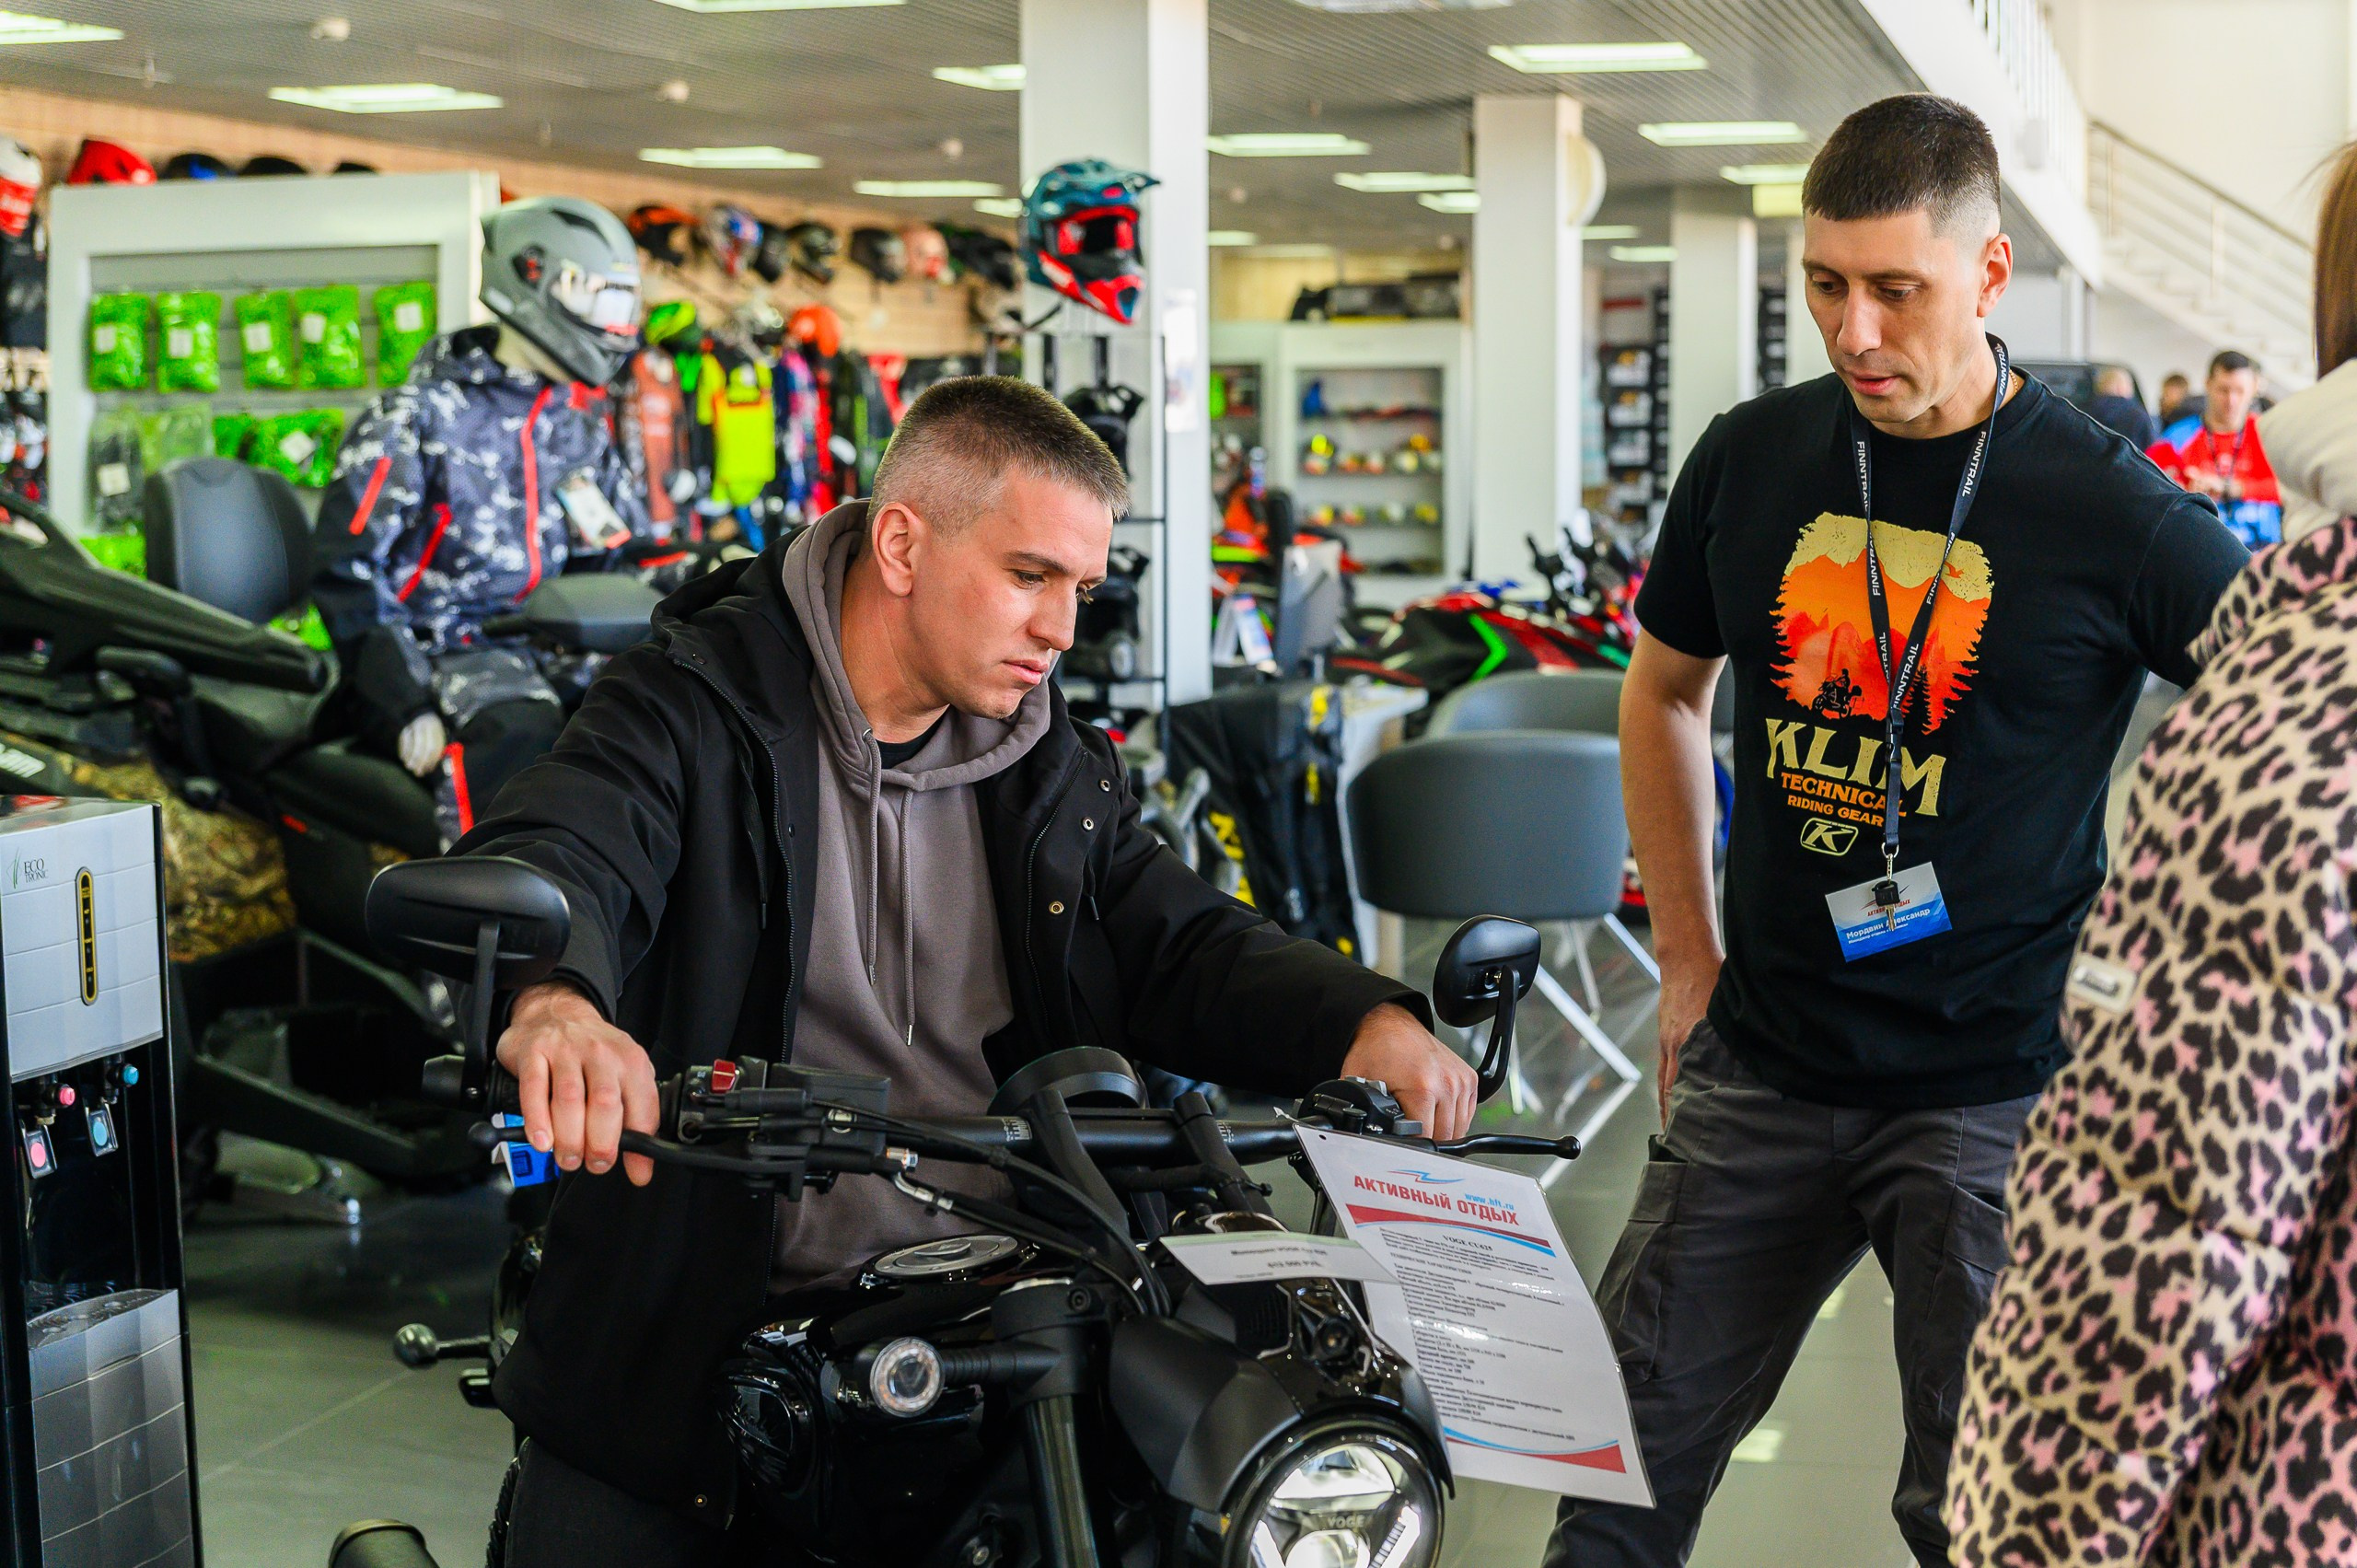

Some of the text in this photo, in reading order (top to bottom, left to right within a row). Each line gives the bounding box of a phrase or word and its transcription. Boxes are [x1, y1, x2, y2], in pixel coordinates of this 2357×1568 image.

[1857, 441, 1870, 513] FINNTRAIL
[1961, 431, 1987, 498] FINNTRAIL
[1869, 532, 1881, 597] FINNTRA
[1765, 717, 1947, 817] KLIM
[1787, 795, 1885, 828] RIDING GEAR
[24, 858, 45, 874] ECO
[25, 870, 49, 883] TRONIC
[1846, 923, 1884, 940] Мордвин
[1353, 1175, 1520, 1226] АКТИВНЫЙ ОТДЫХ
[1464, 1192, 1515, 1212] www.hft.ru
[1327, 1515, 1366, 1528] VOGE
